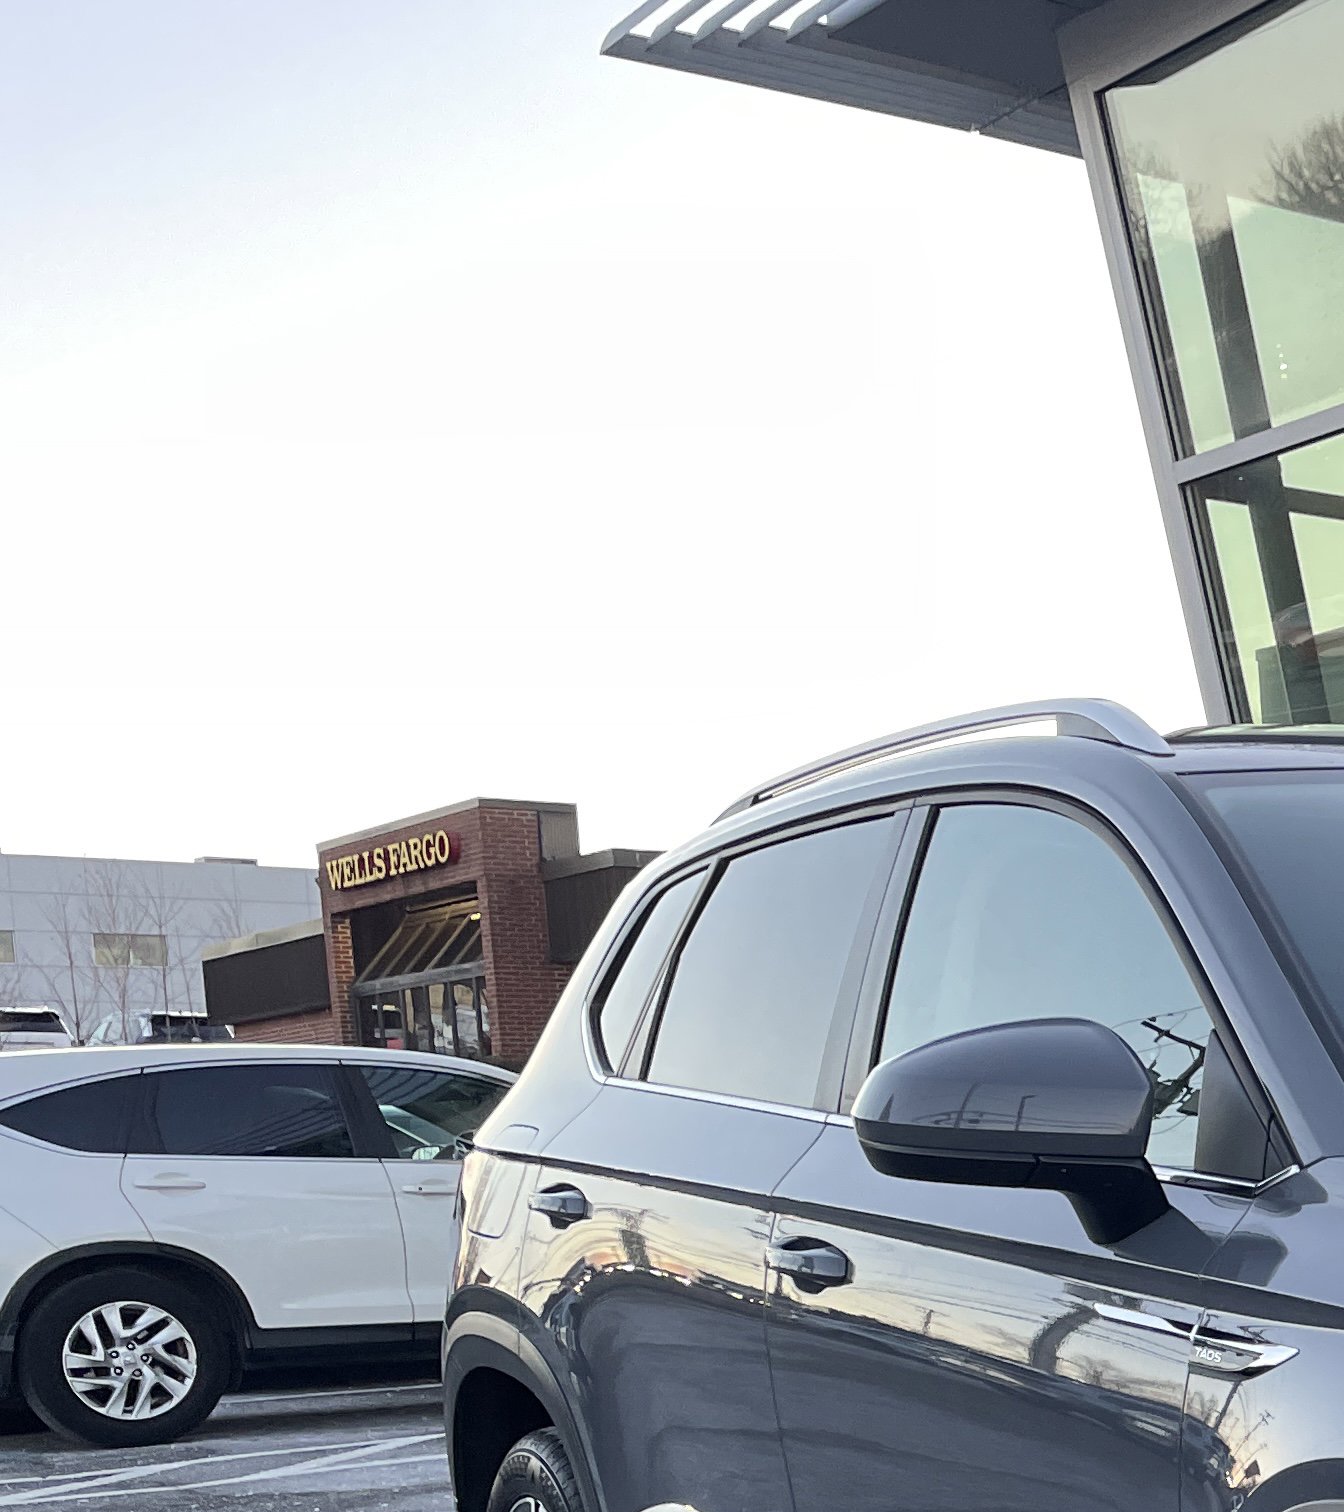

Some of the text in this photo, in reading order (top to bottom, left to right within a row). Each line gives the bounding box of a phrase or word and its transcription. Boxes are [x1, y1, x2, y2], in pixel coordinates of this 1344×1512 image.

[326, 829, 450, 891] WELLS FARGO
[1195, 1347, 1222, 1363] TAOS
